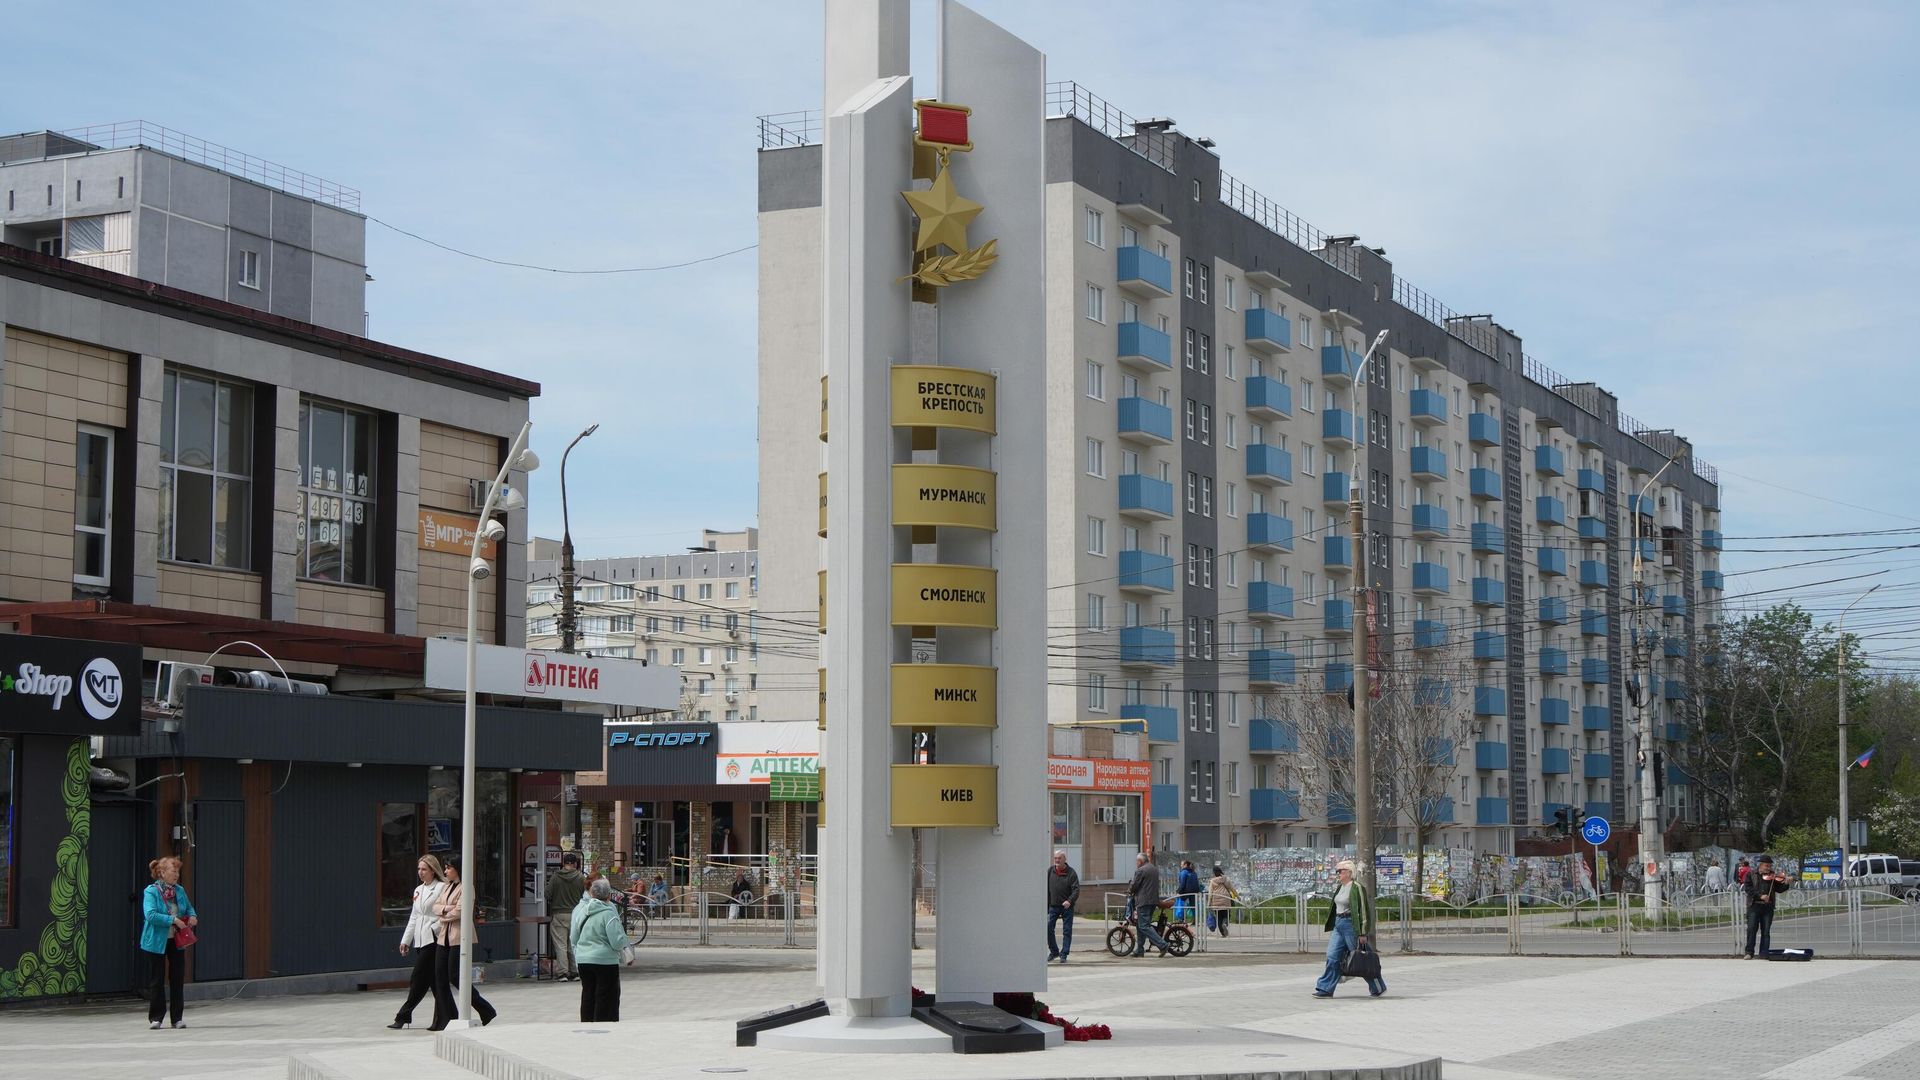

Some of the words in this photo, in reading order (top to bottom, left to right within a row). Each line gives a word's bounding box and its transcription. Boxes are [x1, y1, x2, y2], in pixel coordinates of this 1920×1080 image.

[918, 382, 986, 400] БРЕСТСКАЯ
[922, 397, 984, 415] КРЕПОСТЬ
[919, 488, 986, 505] МУРМАНСК
[436, 524, 463, 544] МПР
[920, 587, 986, 604] СМОЛЕНСК
[527, 659, 599, 690] АПТЕКА
[15, 662, 72, 710] Shop
[91, 674, 119, 694] MT
[934, 688, 977, 702] МИНСК
[609, 731, 711, 747] Р-СПОРТ
[1096, 762, 1128, 777] Народная
[1097, 778, 1129, 790] народные
[941, 789, 974, 802] КИЕВ
